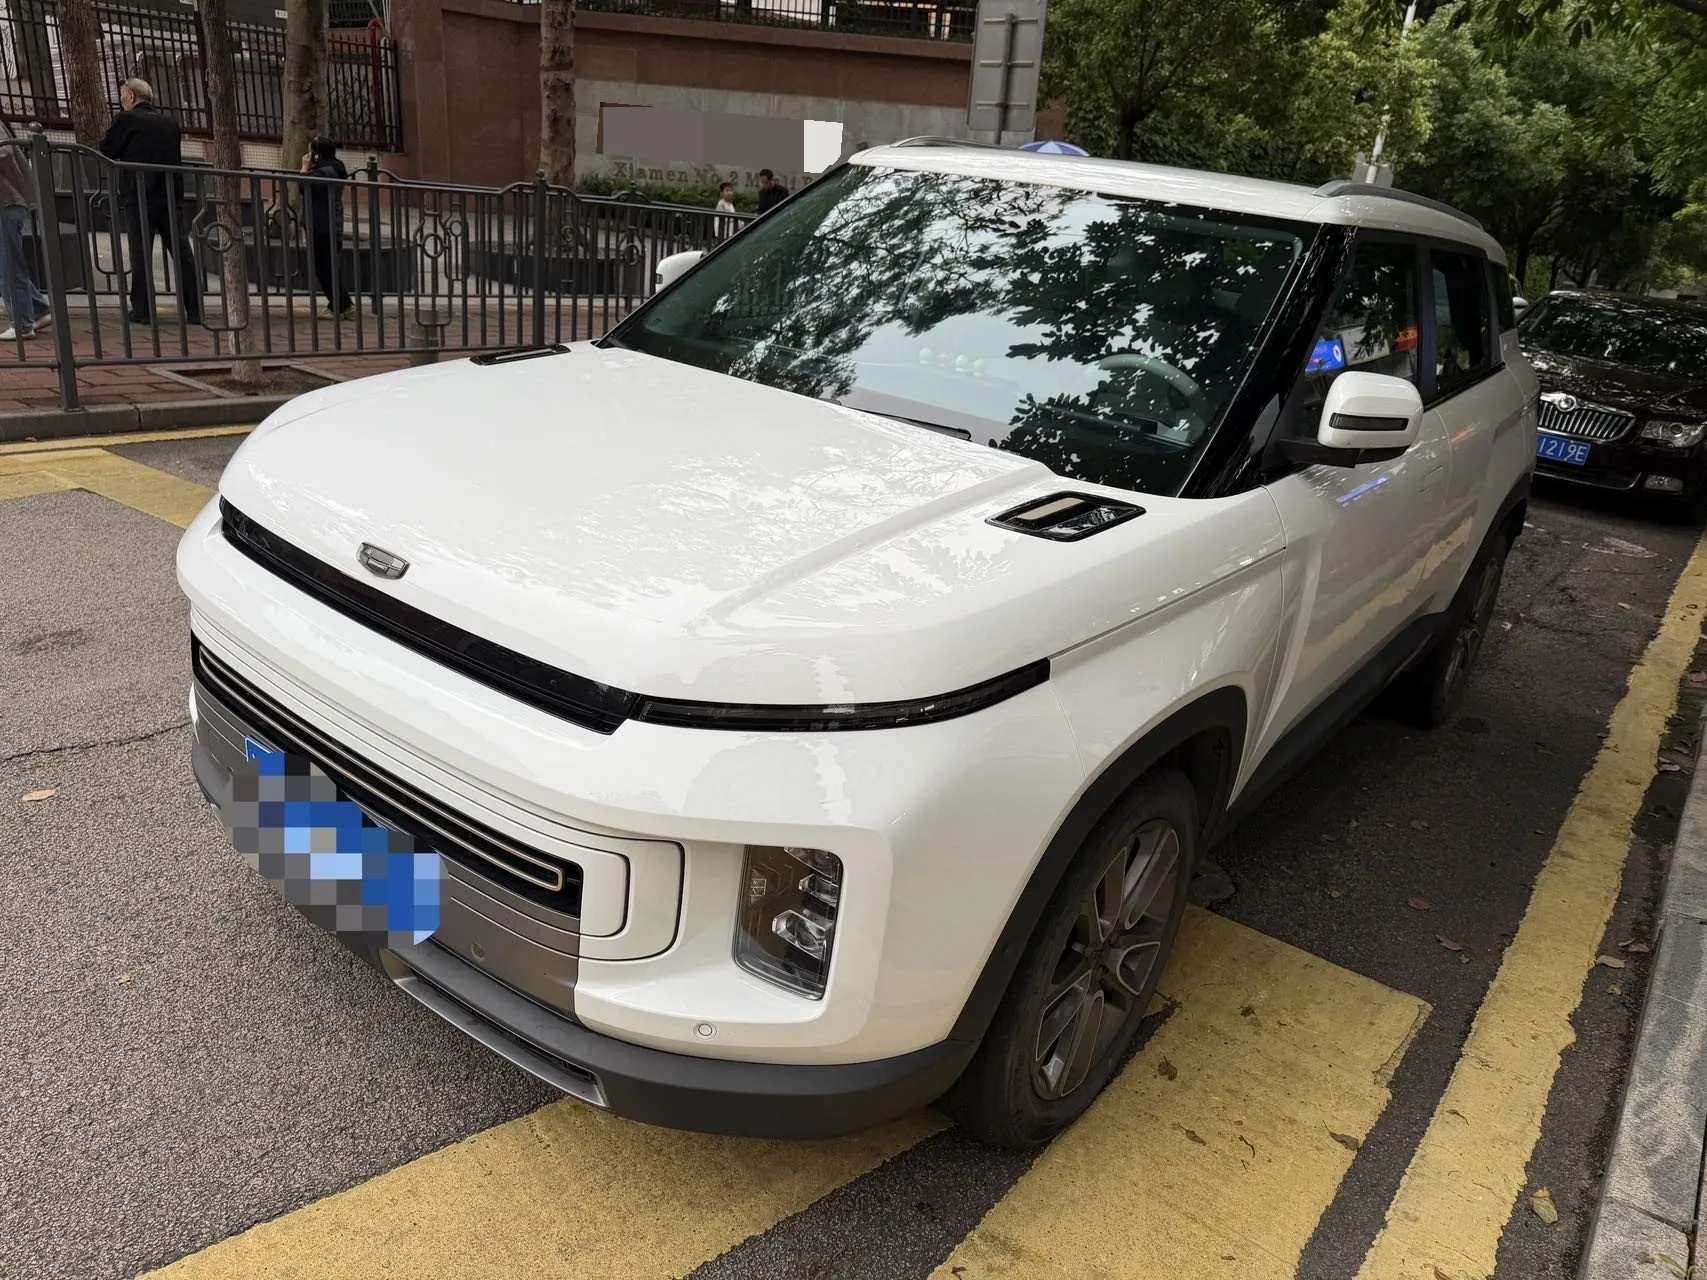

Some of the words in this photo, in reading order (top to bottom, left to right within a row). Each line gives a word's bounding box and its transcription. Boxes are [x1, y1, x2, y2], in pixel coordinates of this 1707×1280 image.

[613, 161, 688, 182] Xiamen
[729, 170, 738, 185] 2
[1539, 438, 1587, 461] 1219E
